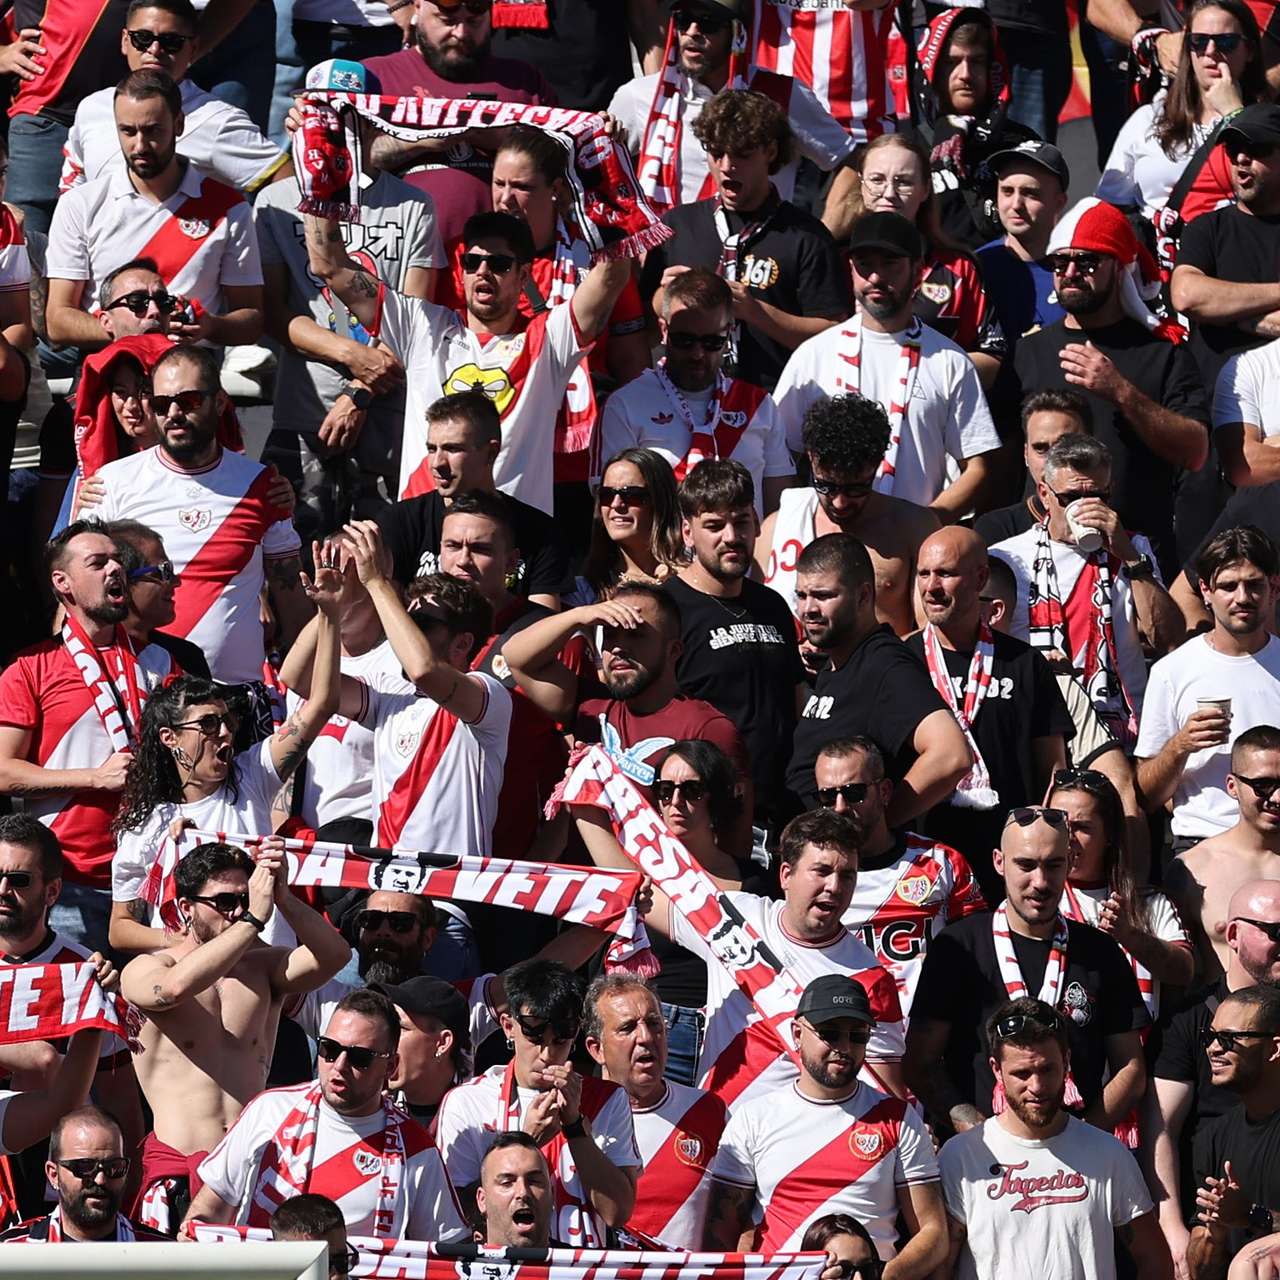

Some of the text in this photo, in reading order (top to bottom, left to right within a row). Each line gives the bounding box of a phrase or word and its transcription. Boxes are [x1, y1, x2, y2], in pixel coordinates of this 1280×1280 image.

[743, 255, 772, 289] 161
[710, 623, 778, 640] LA JUVENTUD
[60, 961, 122, 1028] YA
[987, 1162, 1086, 1201] Torpedos
